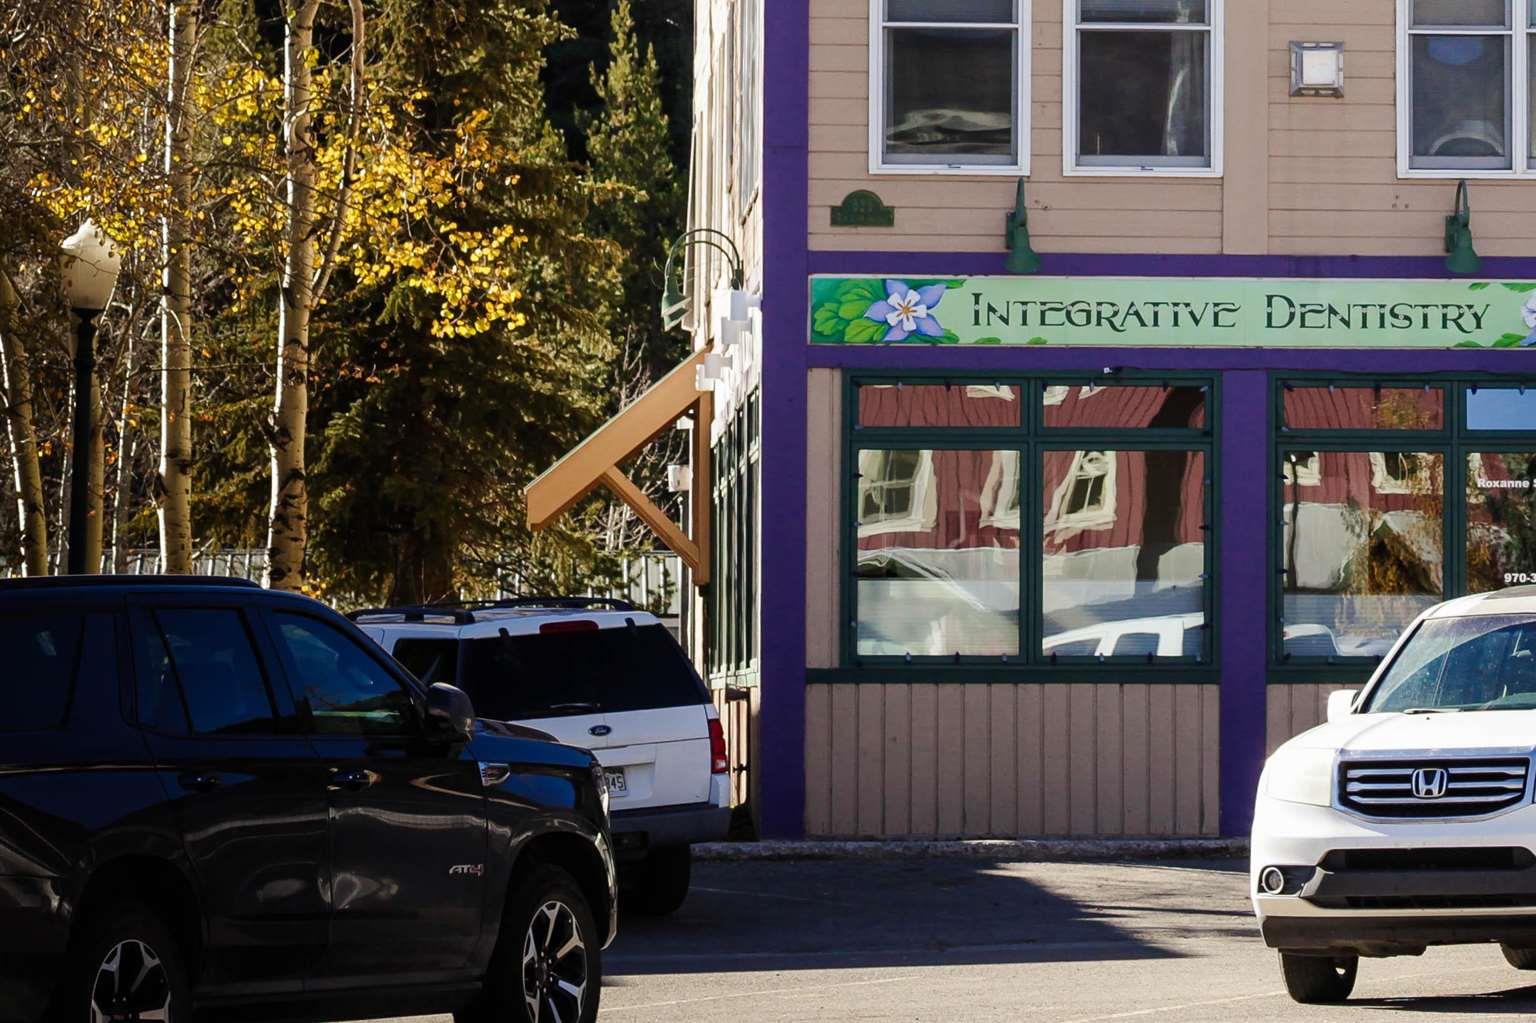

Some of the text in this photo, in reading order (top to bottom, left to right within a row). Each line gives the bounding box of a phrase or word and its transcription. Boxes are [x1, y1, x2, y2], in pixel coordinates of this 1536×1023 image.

[971, 292, 1491, 334] INTEGRATIVE DENTISTRY
[1477, 478, 1530, 489] Roxanne
